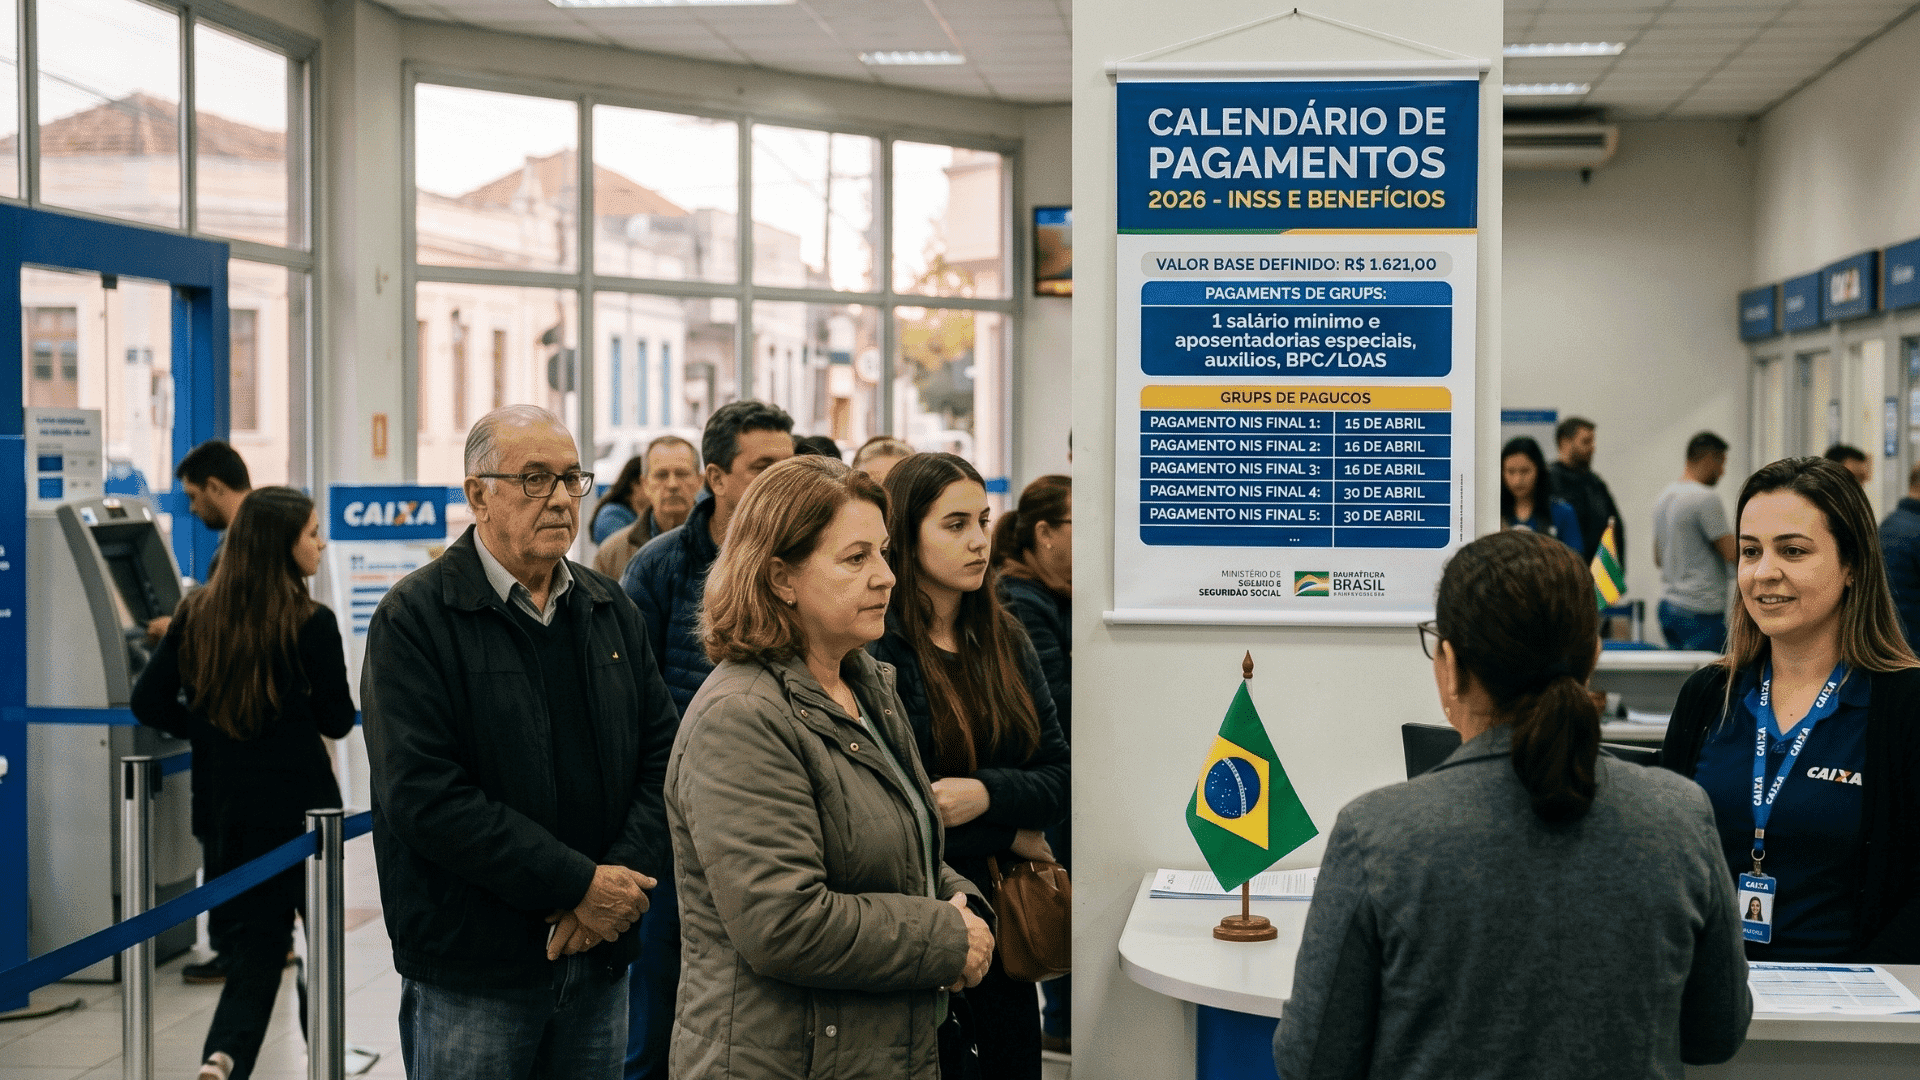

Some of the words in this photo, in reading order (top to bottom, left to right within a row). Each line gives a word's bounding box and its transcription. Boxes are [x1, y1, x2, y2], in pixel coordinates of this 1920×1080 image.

[1148, 100, 1387, 136] CALENDÁRIO
[1399, 107, 1445, 135] DE
[1150, 146, 1445, 178] PAGAMENTOS
[1149, 190, 1206, 208] 2026
[1229, 190, 1281, 208] INSS
[1289, 190, 1300, 208] E
[1308, 185, 1445, 208] BENEFÍCIOS
[1156, 258, 1208, 270] VALOR
[1214, 258, 1254, 270] BASE
[1260, 258, 1339, 270] DEFINIDO:
[1345, 257, 1365, 272] R$
[1370, 258, 1436, 272] 1.621,00
[1206, 287, 1300, 299] PAGAMENTS
[1306, 287, 1325, 299] DE
[1213, 314, 1222, 328] 1
[1227, 313, 1288, 328] salário
[1295, 313, 1363, 328] minimo
[1369, 316, 1380, 328] e
[1176, 332, 1320, 351] aposentadorias
[1325, 333, 1416, 351] especiais,
[1205, 352, 1280, 369] auxílios,
[1287, 352, 1386, 367] BPC/LOAS
[1221, 391, 1271, 403] GRUPS
[1277, 391, 1295, 403] DE
[1300, 392, 1370, 404] PAGUCOS
[1151, 416, 1236, 428] PAGAMENTO
[1240, 416, 1262, 428] NIS
[1267, 416, 1306, 428] FINAL
[1310, 418, 1320, 428] 1:
[1346, 417, 1360, 429] 15
[1364, 417, 1382, 428] DE
[1385, 417, 1425, 429] ABRIL
[1151, 439, 1236, 450] PAGAMENTO
[1240, 439, 1262, 451] NIS
[1266, 439, 1306, 451] FINAL
[1309, 441, 1320, 451] 2:
[1345, 441, 1360, 452] 16
[1364, 440, 1382, 452] DE
[1385, 440, 1425, 452] ABRIL
[1151, 462, 1236, 474] PAGAMENTO
[1240, 462, 1262, 474] NIS
[1266, 462, 1306, 474] FINAL
[1309, 463, 1320, 475] 3:
[1345, 463, 1360, 475] 16
[1364, 463, 1381, 474] DE
[1385, 463, 1425, 475] ABRIL
[1151, 484, 1236, 496] PAGAMENTO
[1240, 485, 1262, 497] NIS
[1266, 485, 1305, 497] FINAL
[1309, 486, 1320, 497] 4:
[1344, 487, 1360, 499] 30
[1364, 486, 1381, 498] DE
[1384, 486, 1425, 498] ABRIL
[344, 501, 436, 526] CAIXA
[1150, 508, 1236, 520] PAGAMENTO
[1240, 508, 1262, 520] NIS
[1266, 508, 1305, 520] FINAL
[1309, 509, 1320, 520] 5:
[1344, 510, 1360, 522] 30
[1364, 509, 1381, 521] DE
[1384, 509, 1425, 521] ABRIL
[1222, 569, 1267, 578] MINISTÉRIO
[1268, 570, 1281, 578] DE
[1334, 578, 1384, 590] BRASIL
[1816, 681, 1837, 708] CAIXA
[1756, 726, 1767, 757] CAIXA
[1790, 727, 1811, 757] CAIXA
[1807, 766, 1863, 786] CAIXA
[1753, 776, 1763, 807] CAIXA
[1765, 776, 1785, 805] CAIXA
